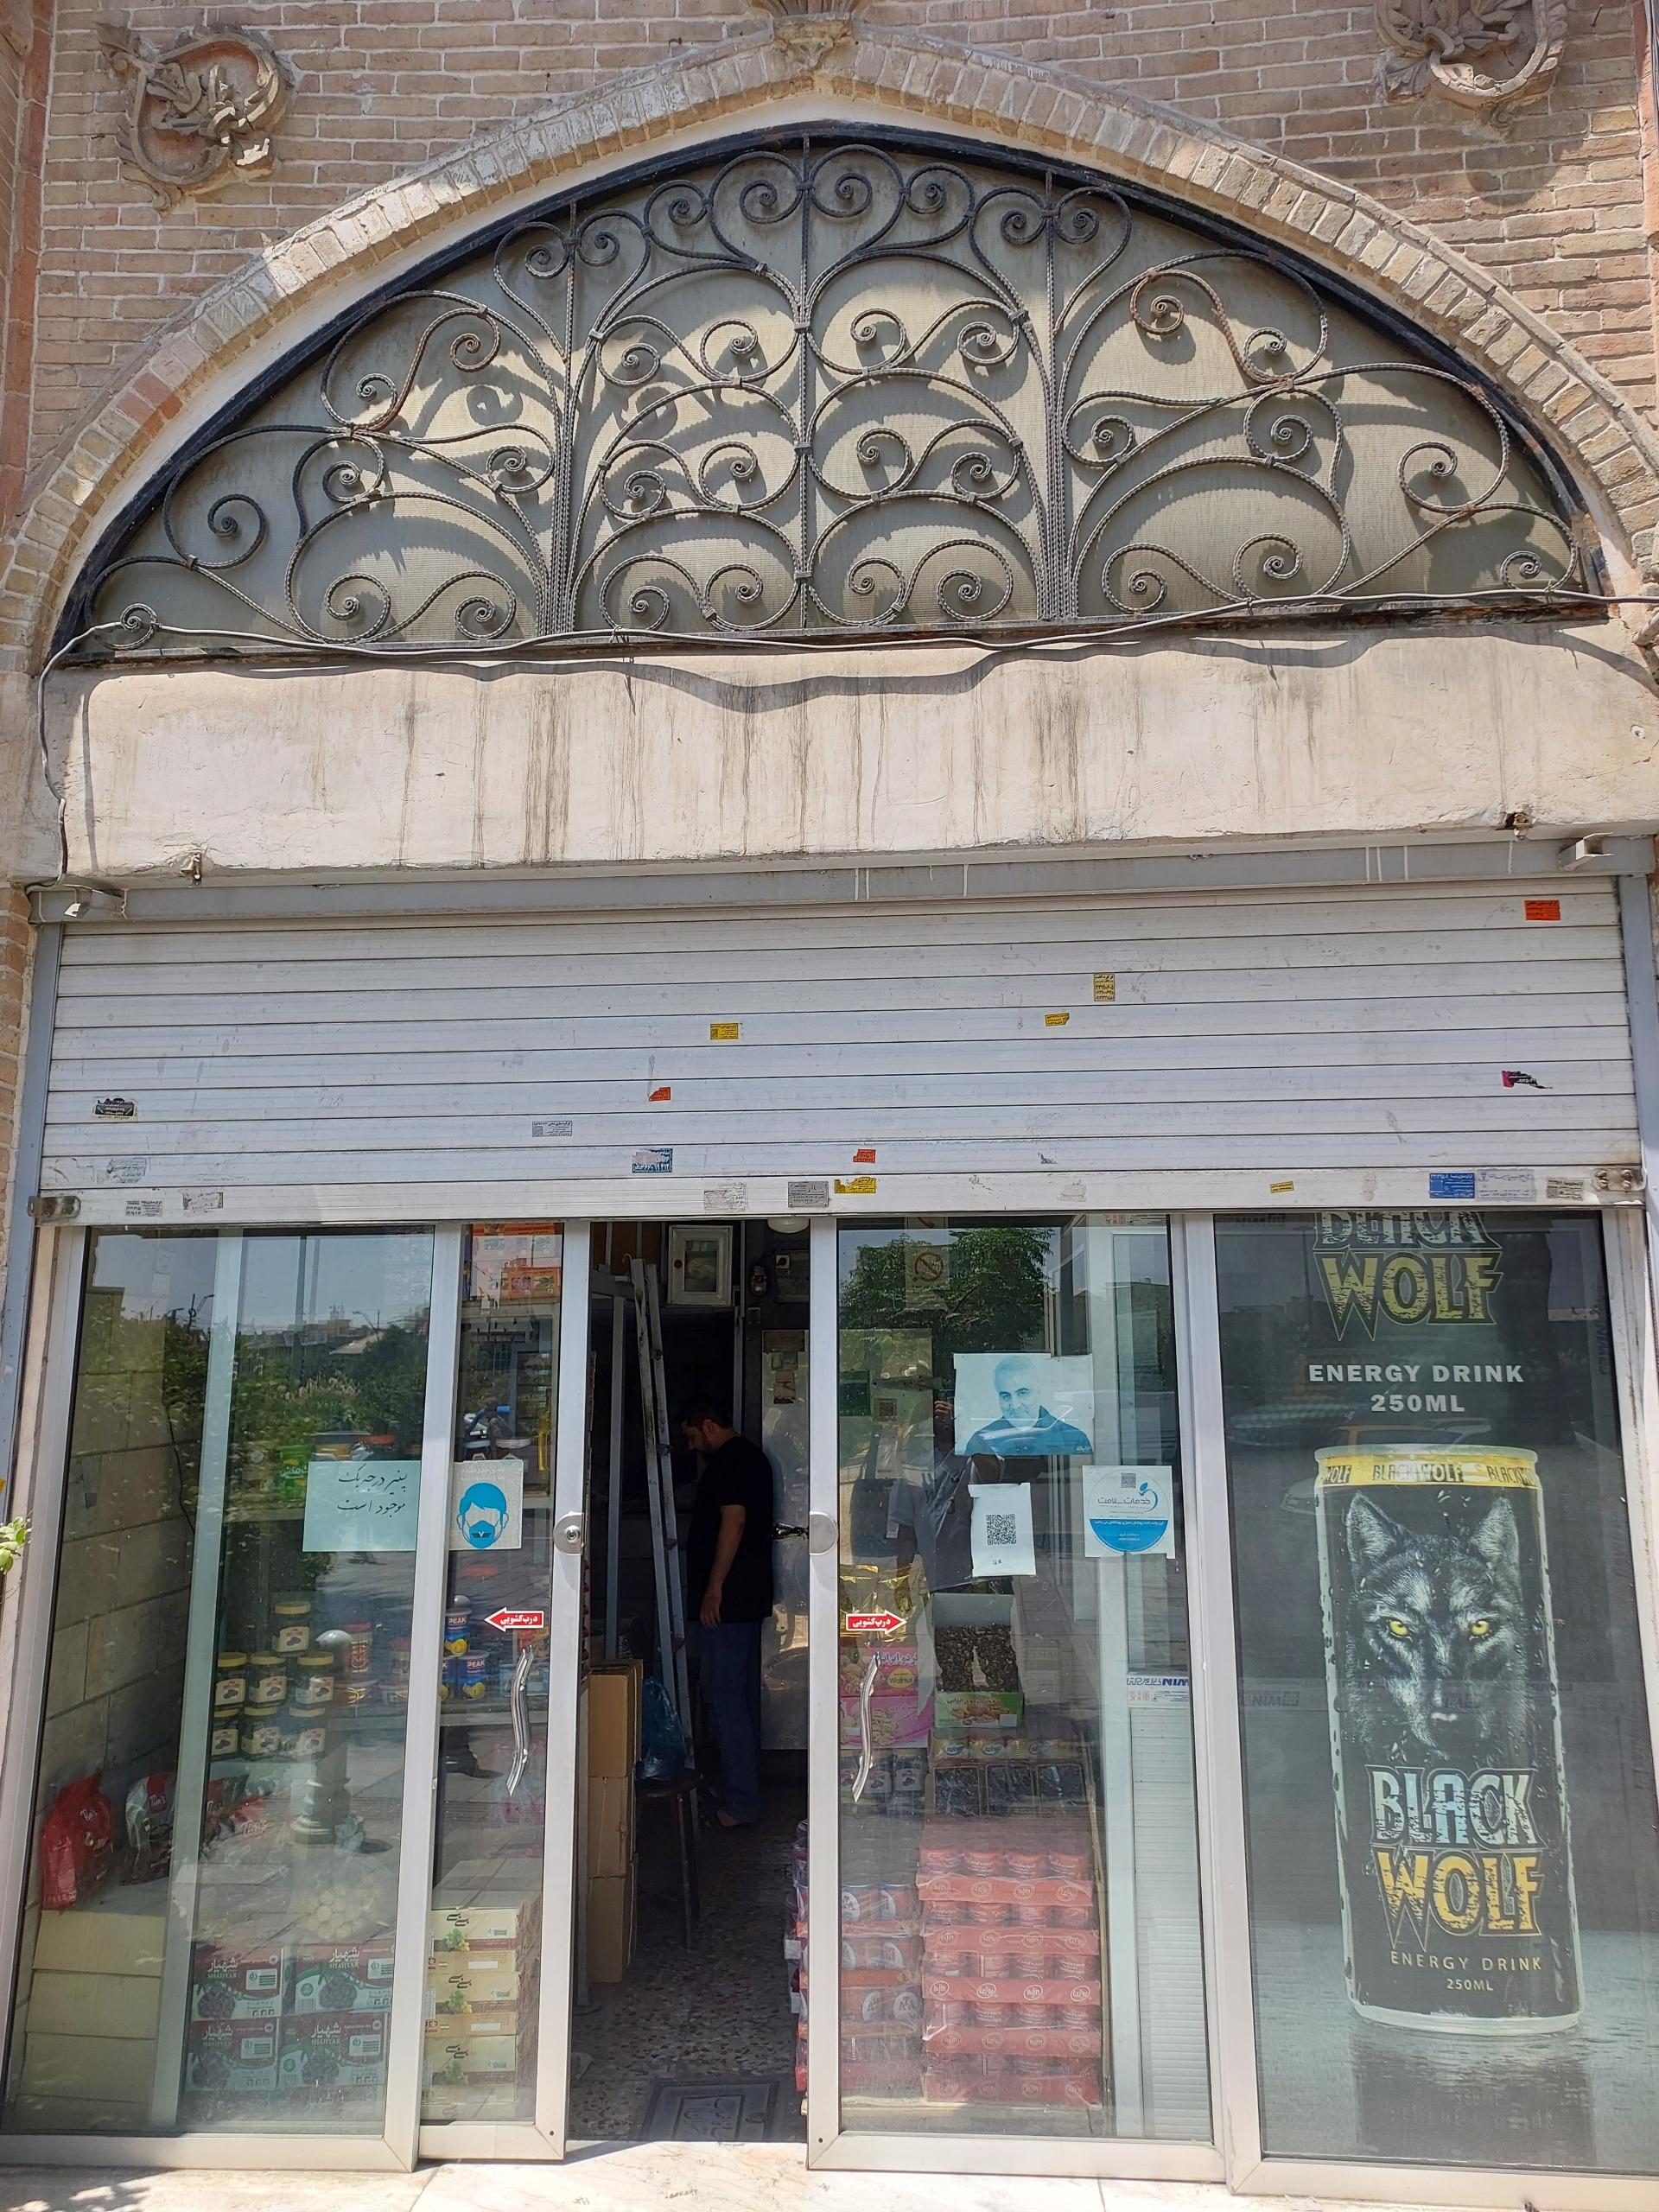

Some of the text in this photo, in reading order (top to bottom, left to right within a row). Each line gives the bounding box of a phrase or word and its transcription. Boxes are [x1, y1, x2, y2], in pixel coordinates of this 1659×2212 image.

[1317, 1255, 1499, 1331] WOLF
[1309, 1365, 1524, 1382] ENERGY DRINK
[1370, 1395, 1465, 1413] 250ML
[338, 1462, 408, 1495] پنیر درجه یک
[337, 1499, 406, 1518] موجود است
[1370, 1770, 1538, 1846] BLACK
[1375, 1851, 1540, 1934] WOLF
[328, 1946, 360, 1963] شهیار
[1390, 1951, 1541, 1971] ENERGY DRINK
[207, 1956, 238, 1973] شهیار
[1446, 1979, 1494, 1992] 250ML
[311, 2022, 342, 2038] شهیار
